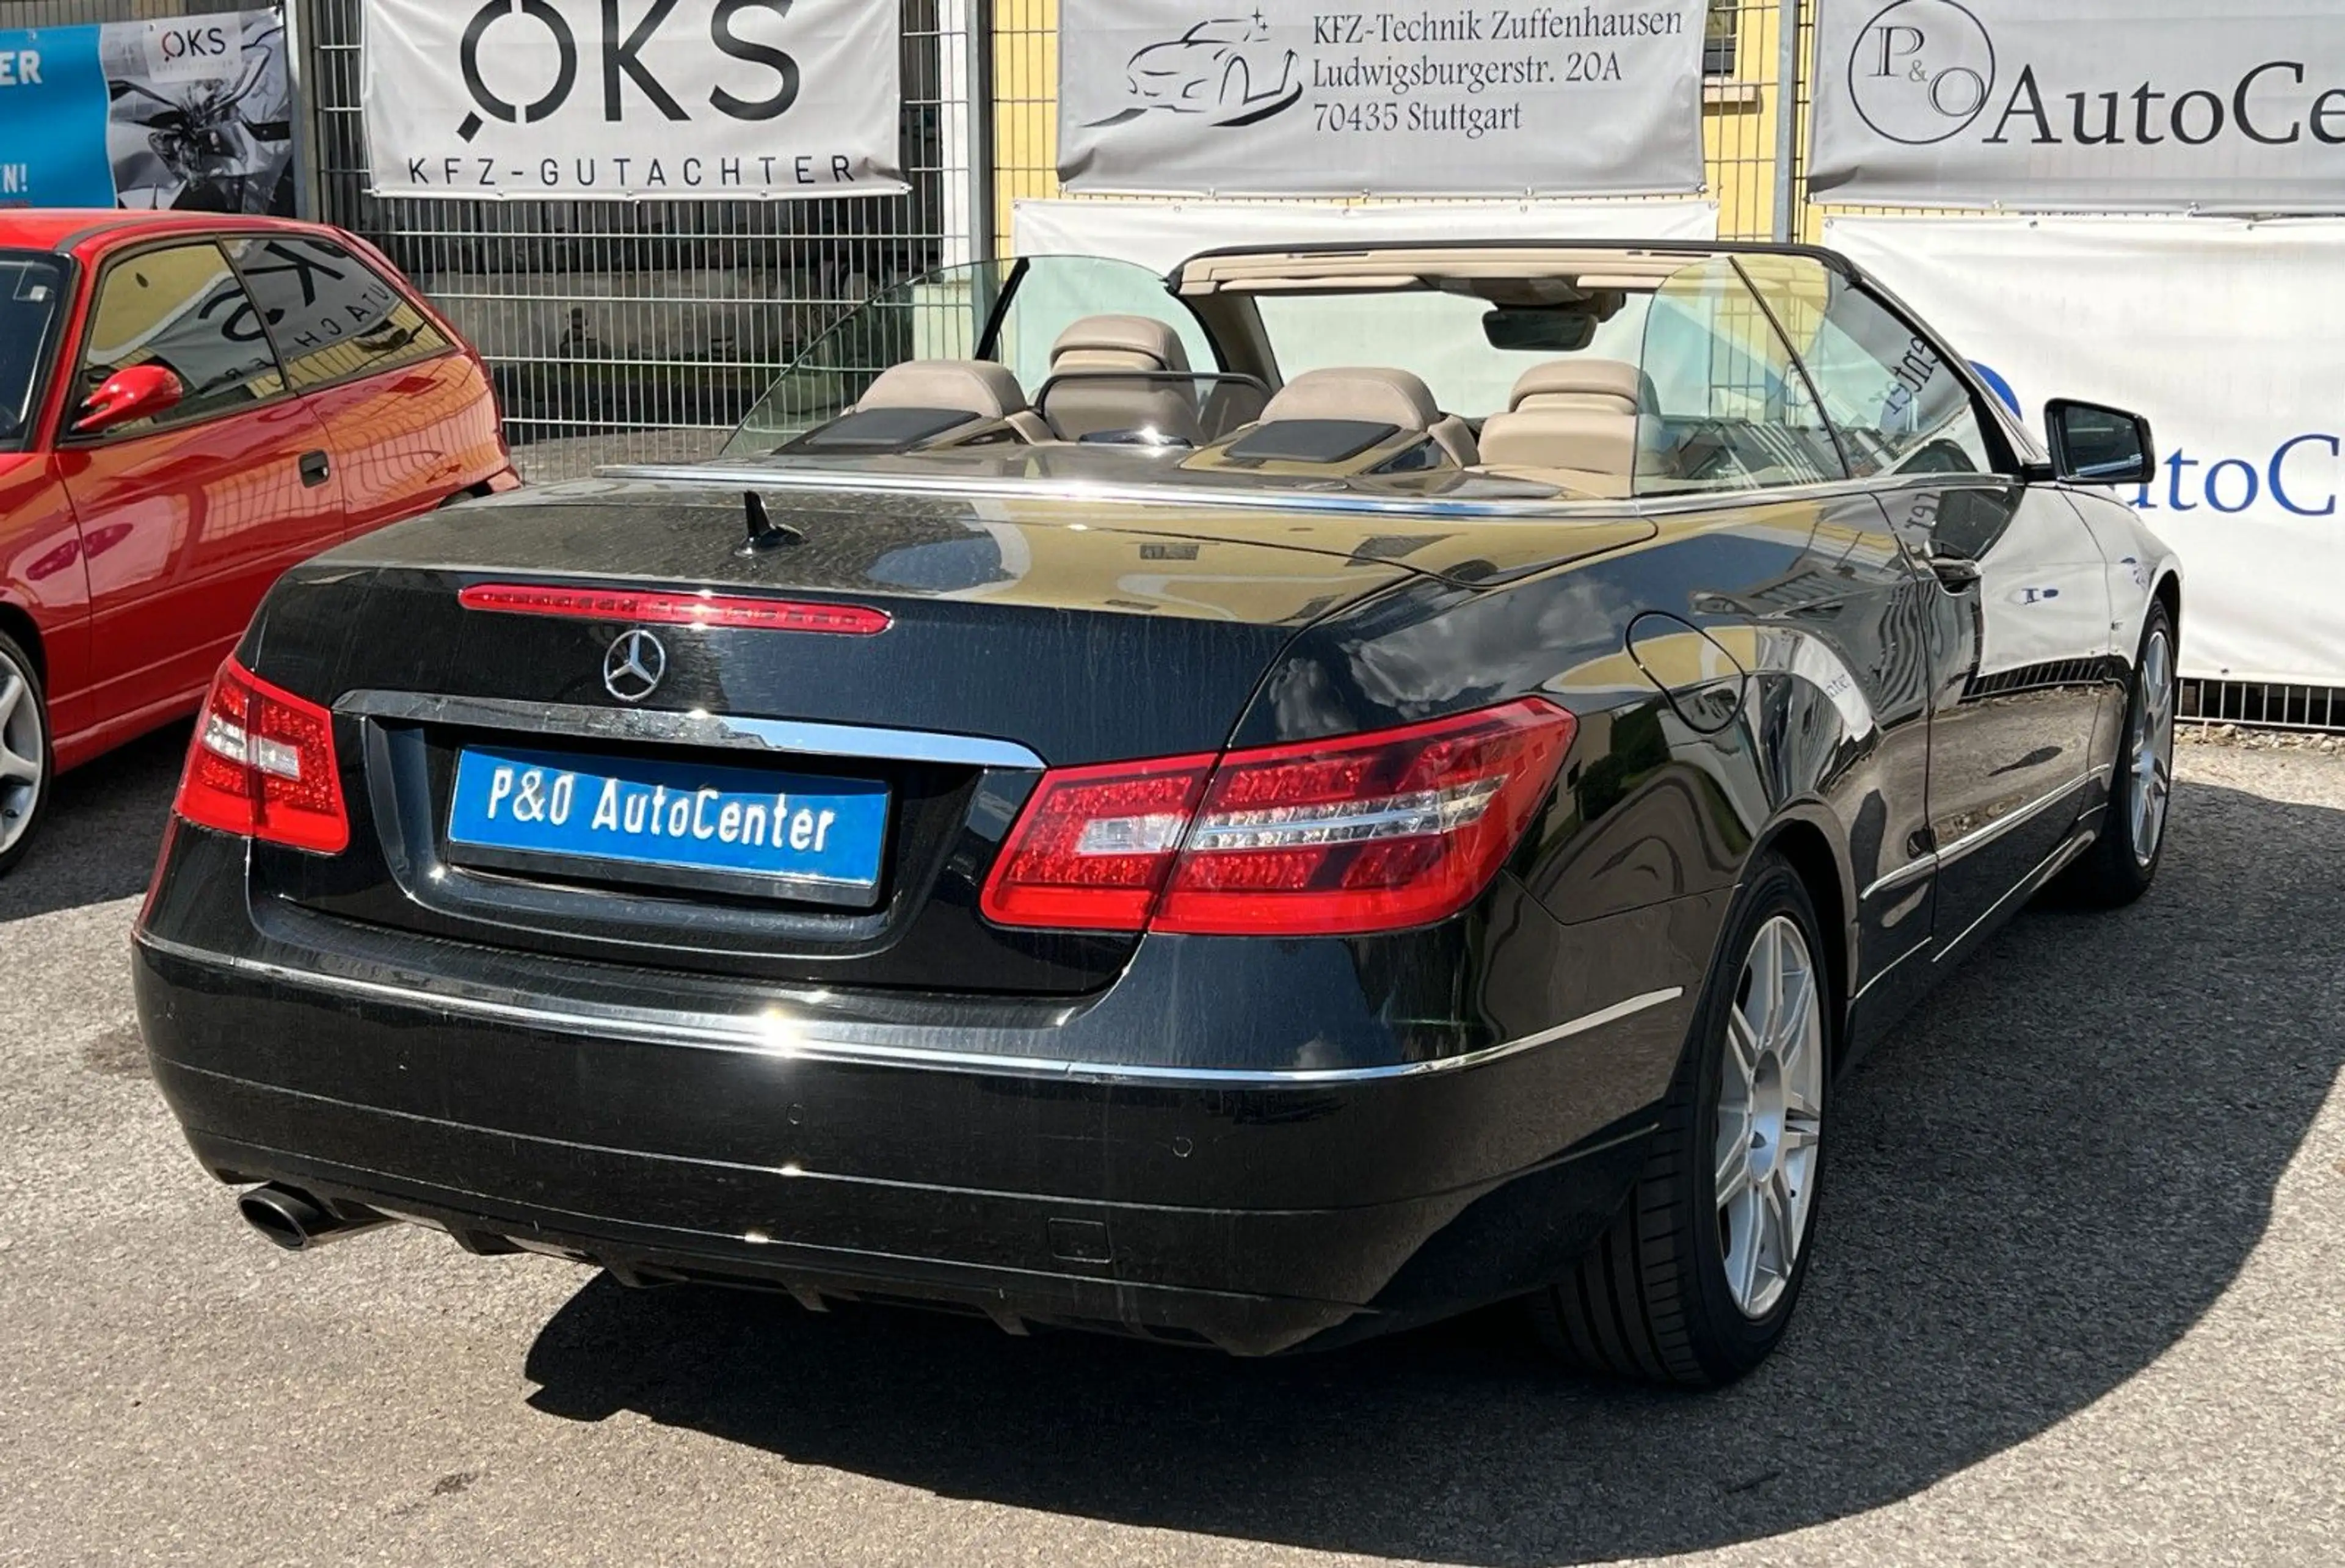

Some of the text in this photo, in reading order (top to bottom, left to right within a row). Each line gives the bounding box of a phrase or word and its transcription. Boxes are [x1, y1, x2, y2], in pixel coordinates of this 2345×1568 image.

[1313, 7, 1682, 44] KFZ-Technik Zuffenhausen
[1313, 51, 1622, 95] Ludwigsburgerstr. 20A
[1314, 101, 1524, 139] 70435 Stuttgart
[0, 163, 28, 194] N!
[409, 154, 856, 186] KFZ-GUTACHTER
[489, 767, 836, 852] P&O AutoCenter
